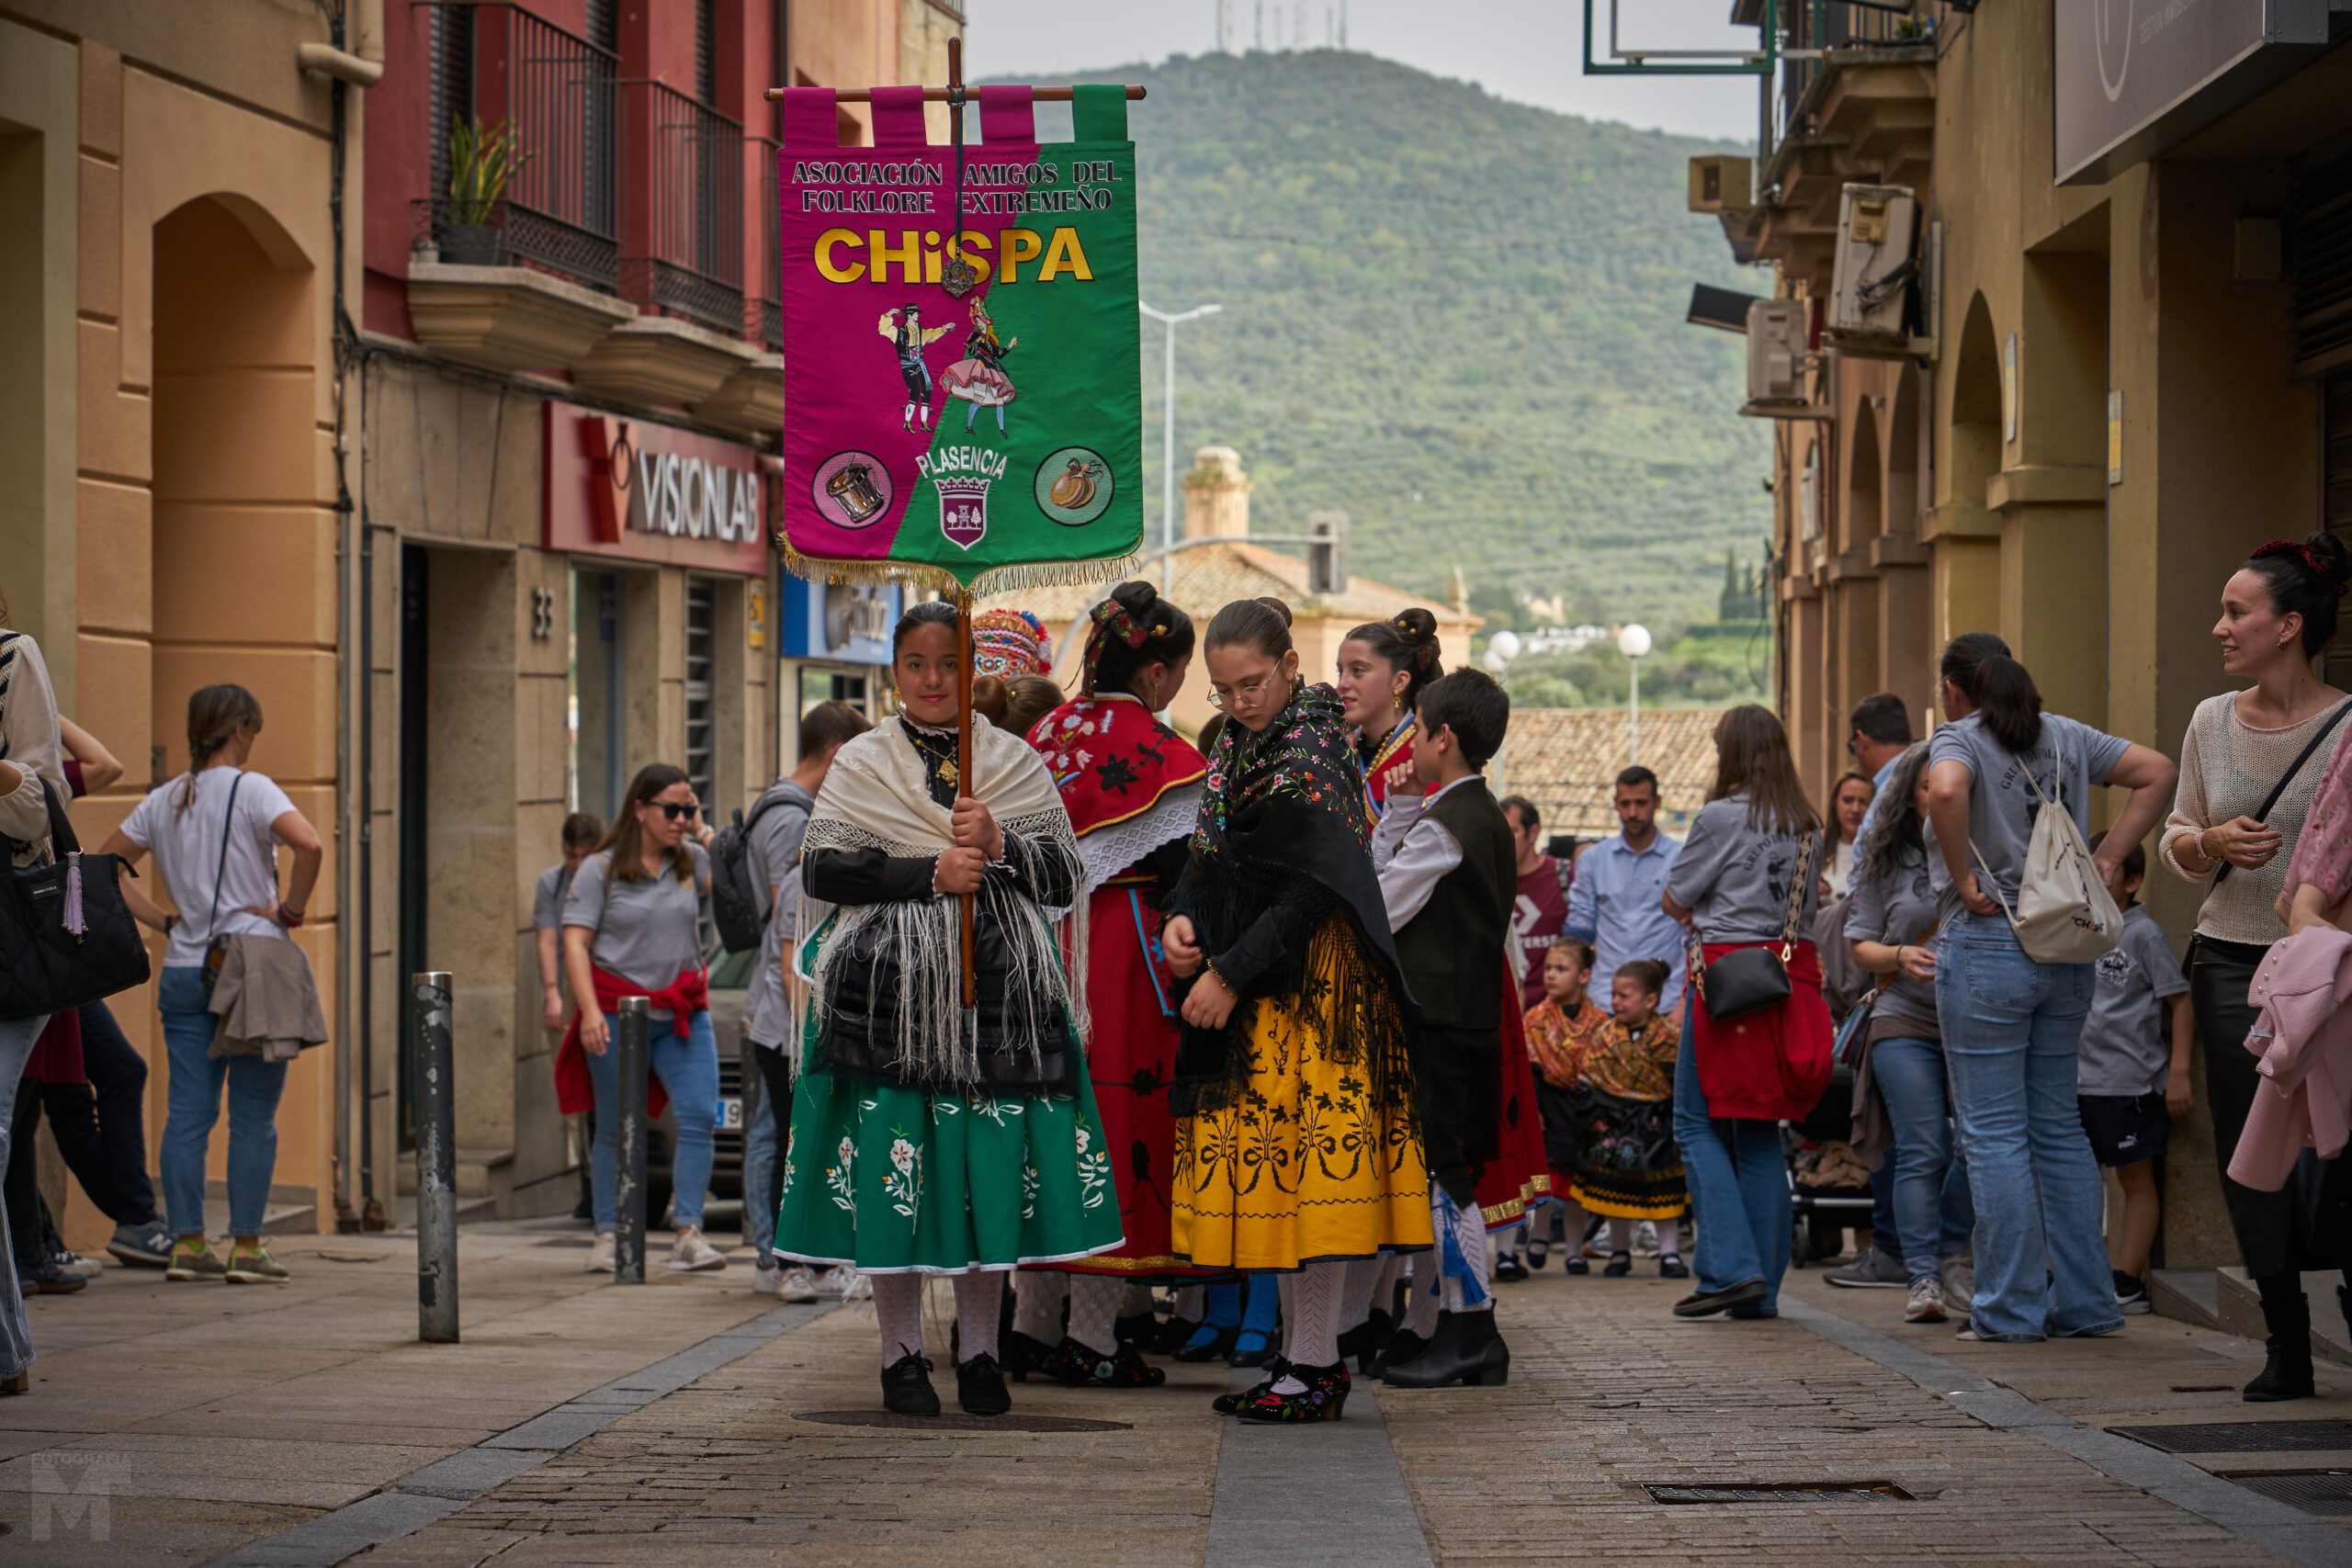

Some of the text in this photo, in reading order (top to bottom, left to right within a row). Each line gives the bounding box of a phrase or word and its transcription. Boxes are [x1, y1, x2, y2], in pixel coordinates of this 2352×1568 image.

[792, 159, 1122, 186] ASOCIACIÓN AMIGOS DEL
[802, 184, 1113, 214] FOLKLORE EXTREMEÑO
[915, 446, 1008, 479] PLASENCIA
[639, 449, 759, 545] VISIONLAB
[531, 588, 553, 641] 33
